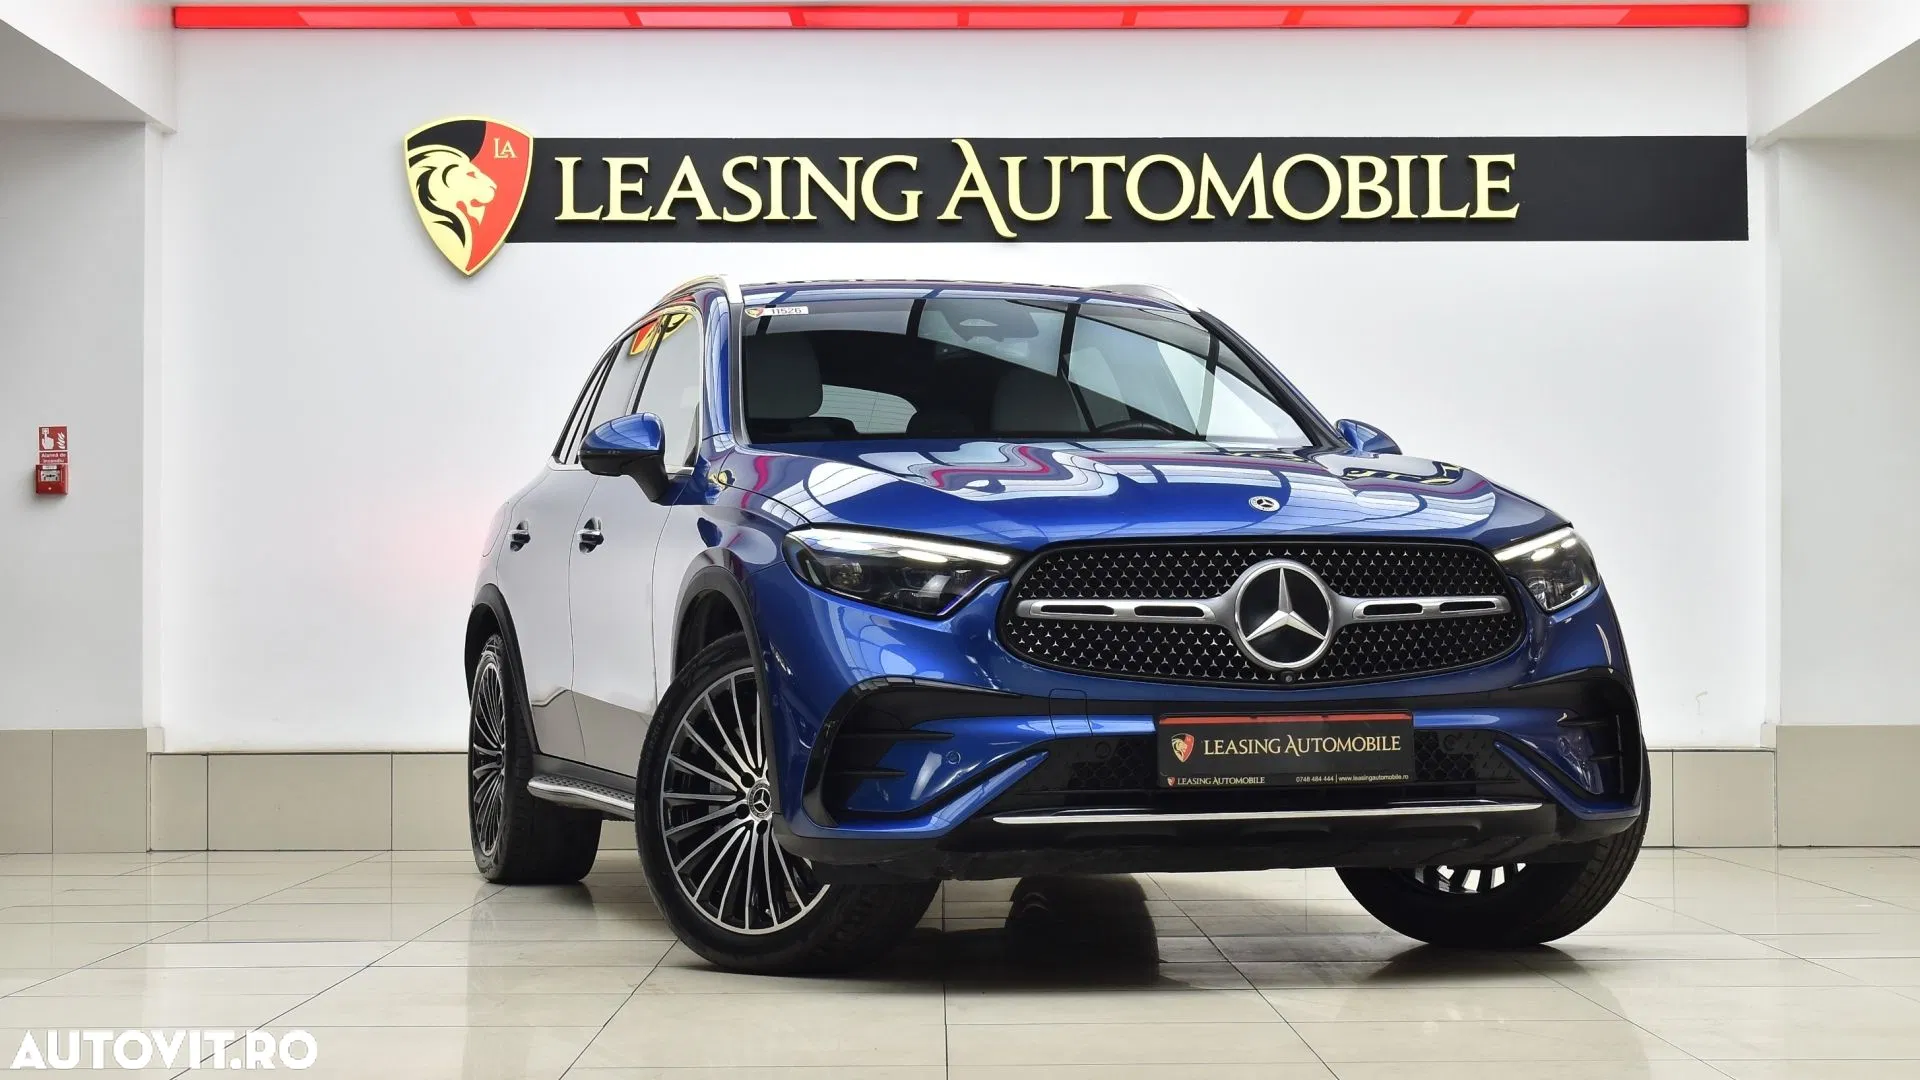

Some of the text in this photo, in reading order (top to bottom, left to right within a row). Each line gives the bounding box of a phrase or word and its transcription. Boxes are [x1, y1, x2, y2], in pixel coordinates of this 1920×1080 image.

[493, 137, 518, 159] LA
[554, 138, 1520, 238] LEASING AUTOMOBILE
[1204, 735, 1401, 757] LEASING AUTOMOBILE
[1177, 776, 1265, 786] LEASING AUTOMOBILE
[1338, 774, 1409, 782] www.leasingautomobile.ro
